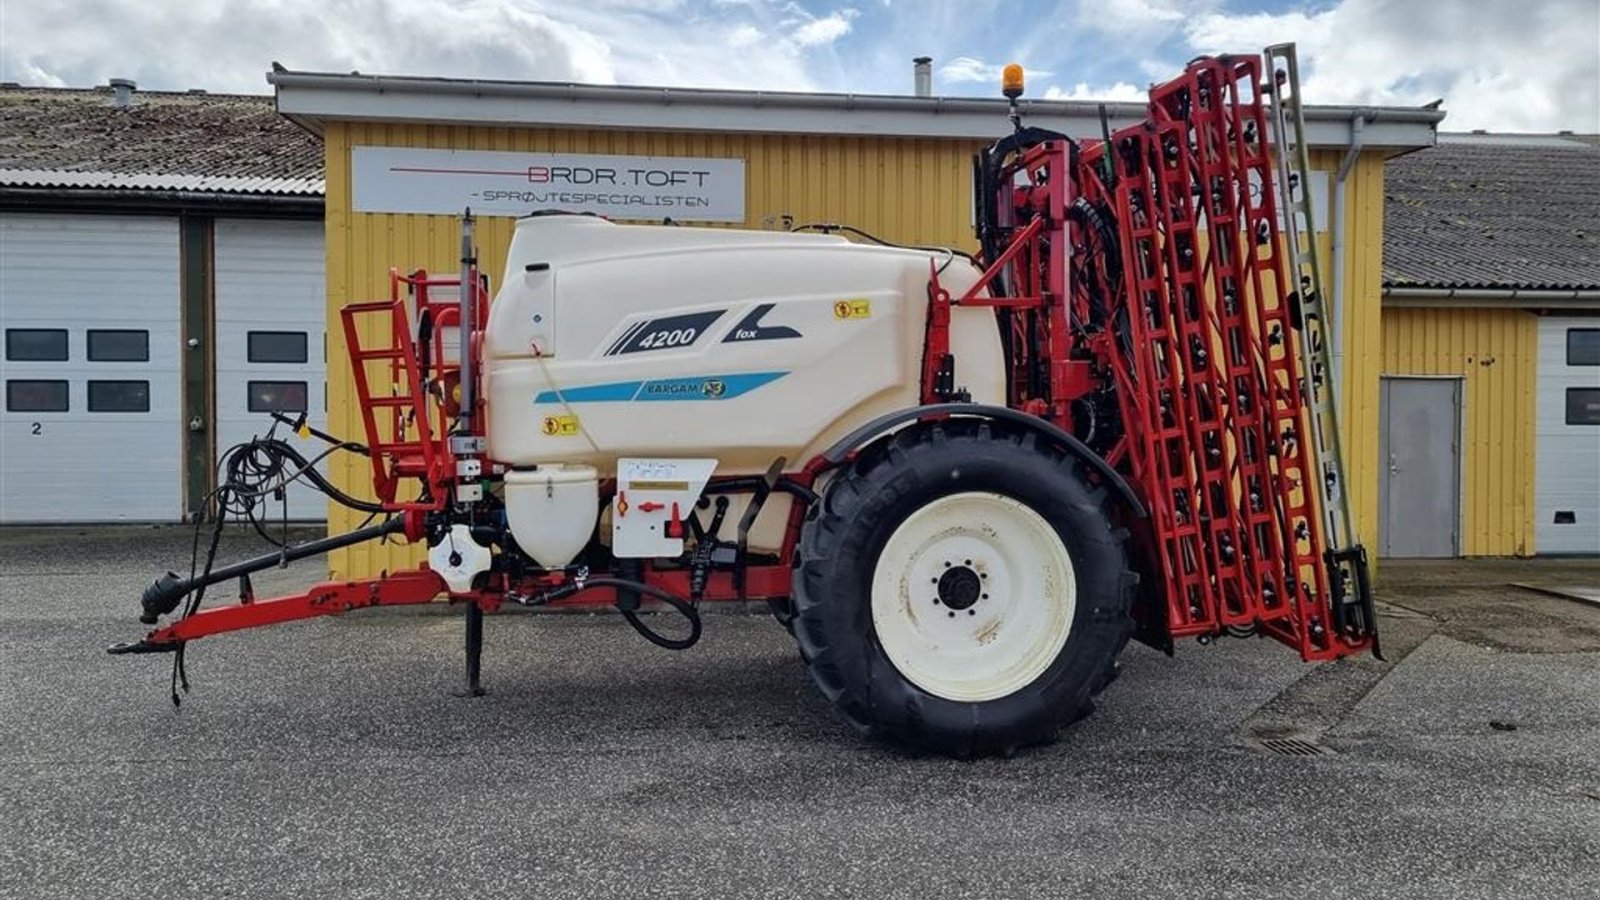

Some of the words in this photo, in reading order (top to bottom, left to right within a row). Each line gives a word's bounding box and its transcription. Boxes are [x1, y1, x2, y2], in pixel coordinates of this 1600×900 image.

[639, 327, 696, 349] 4200
[735, 329, 758, 340] fox
[32, 422, 42, 436] 2
